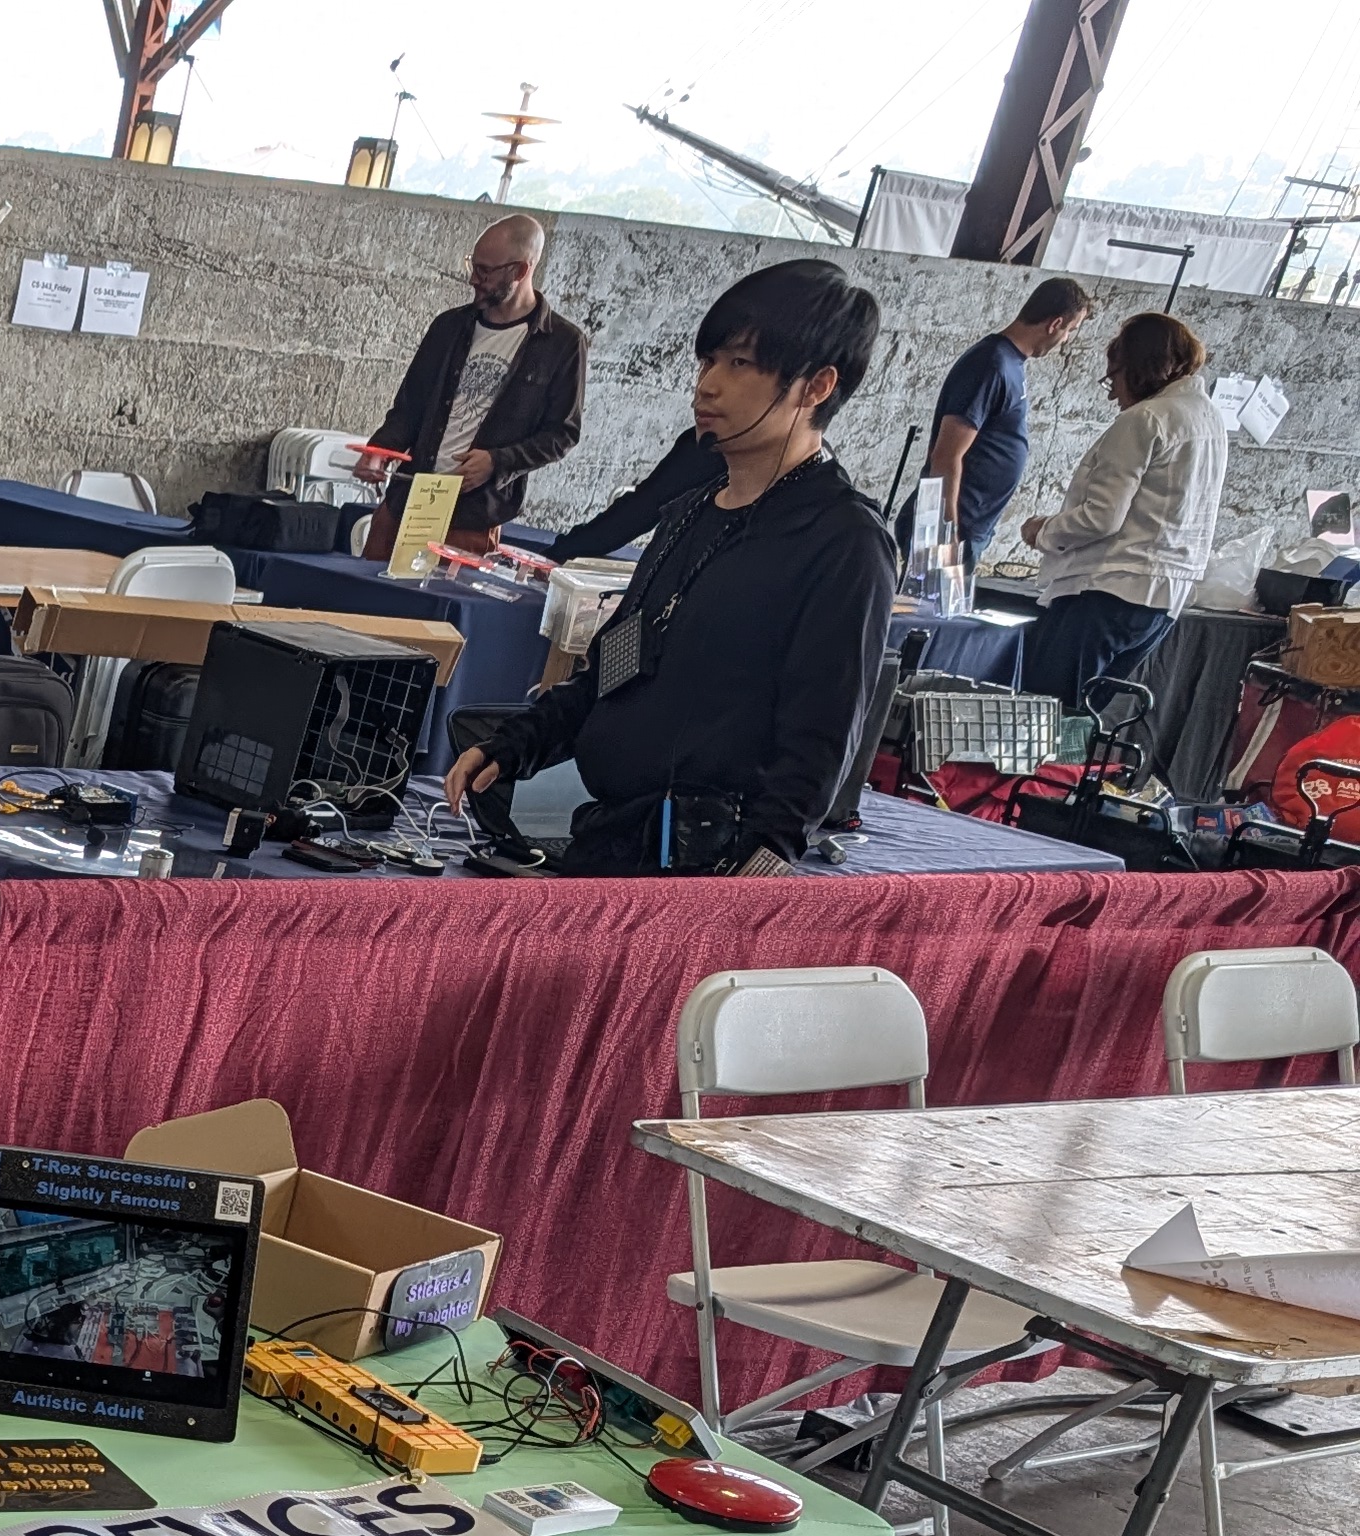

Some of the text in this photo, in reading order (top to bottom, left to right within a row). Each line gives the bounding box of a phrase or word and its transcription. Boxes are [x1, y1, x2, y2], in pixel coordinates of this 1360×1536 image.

[31, 1156, 187, 1189] T-Rex Successful
[36, 1181, 181, 1211] Slightly Famous
[406, 1268, 472, 1303] Stickers 4
[394, 1300, 474, 1337] My Daughter
[12, 1390, 145, 1421] Autistic Adult
[11, 1445, 99, 1459] Needs
[7, 1461, 106, 1475] Source
